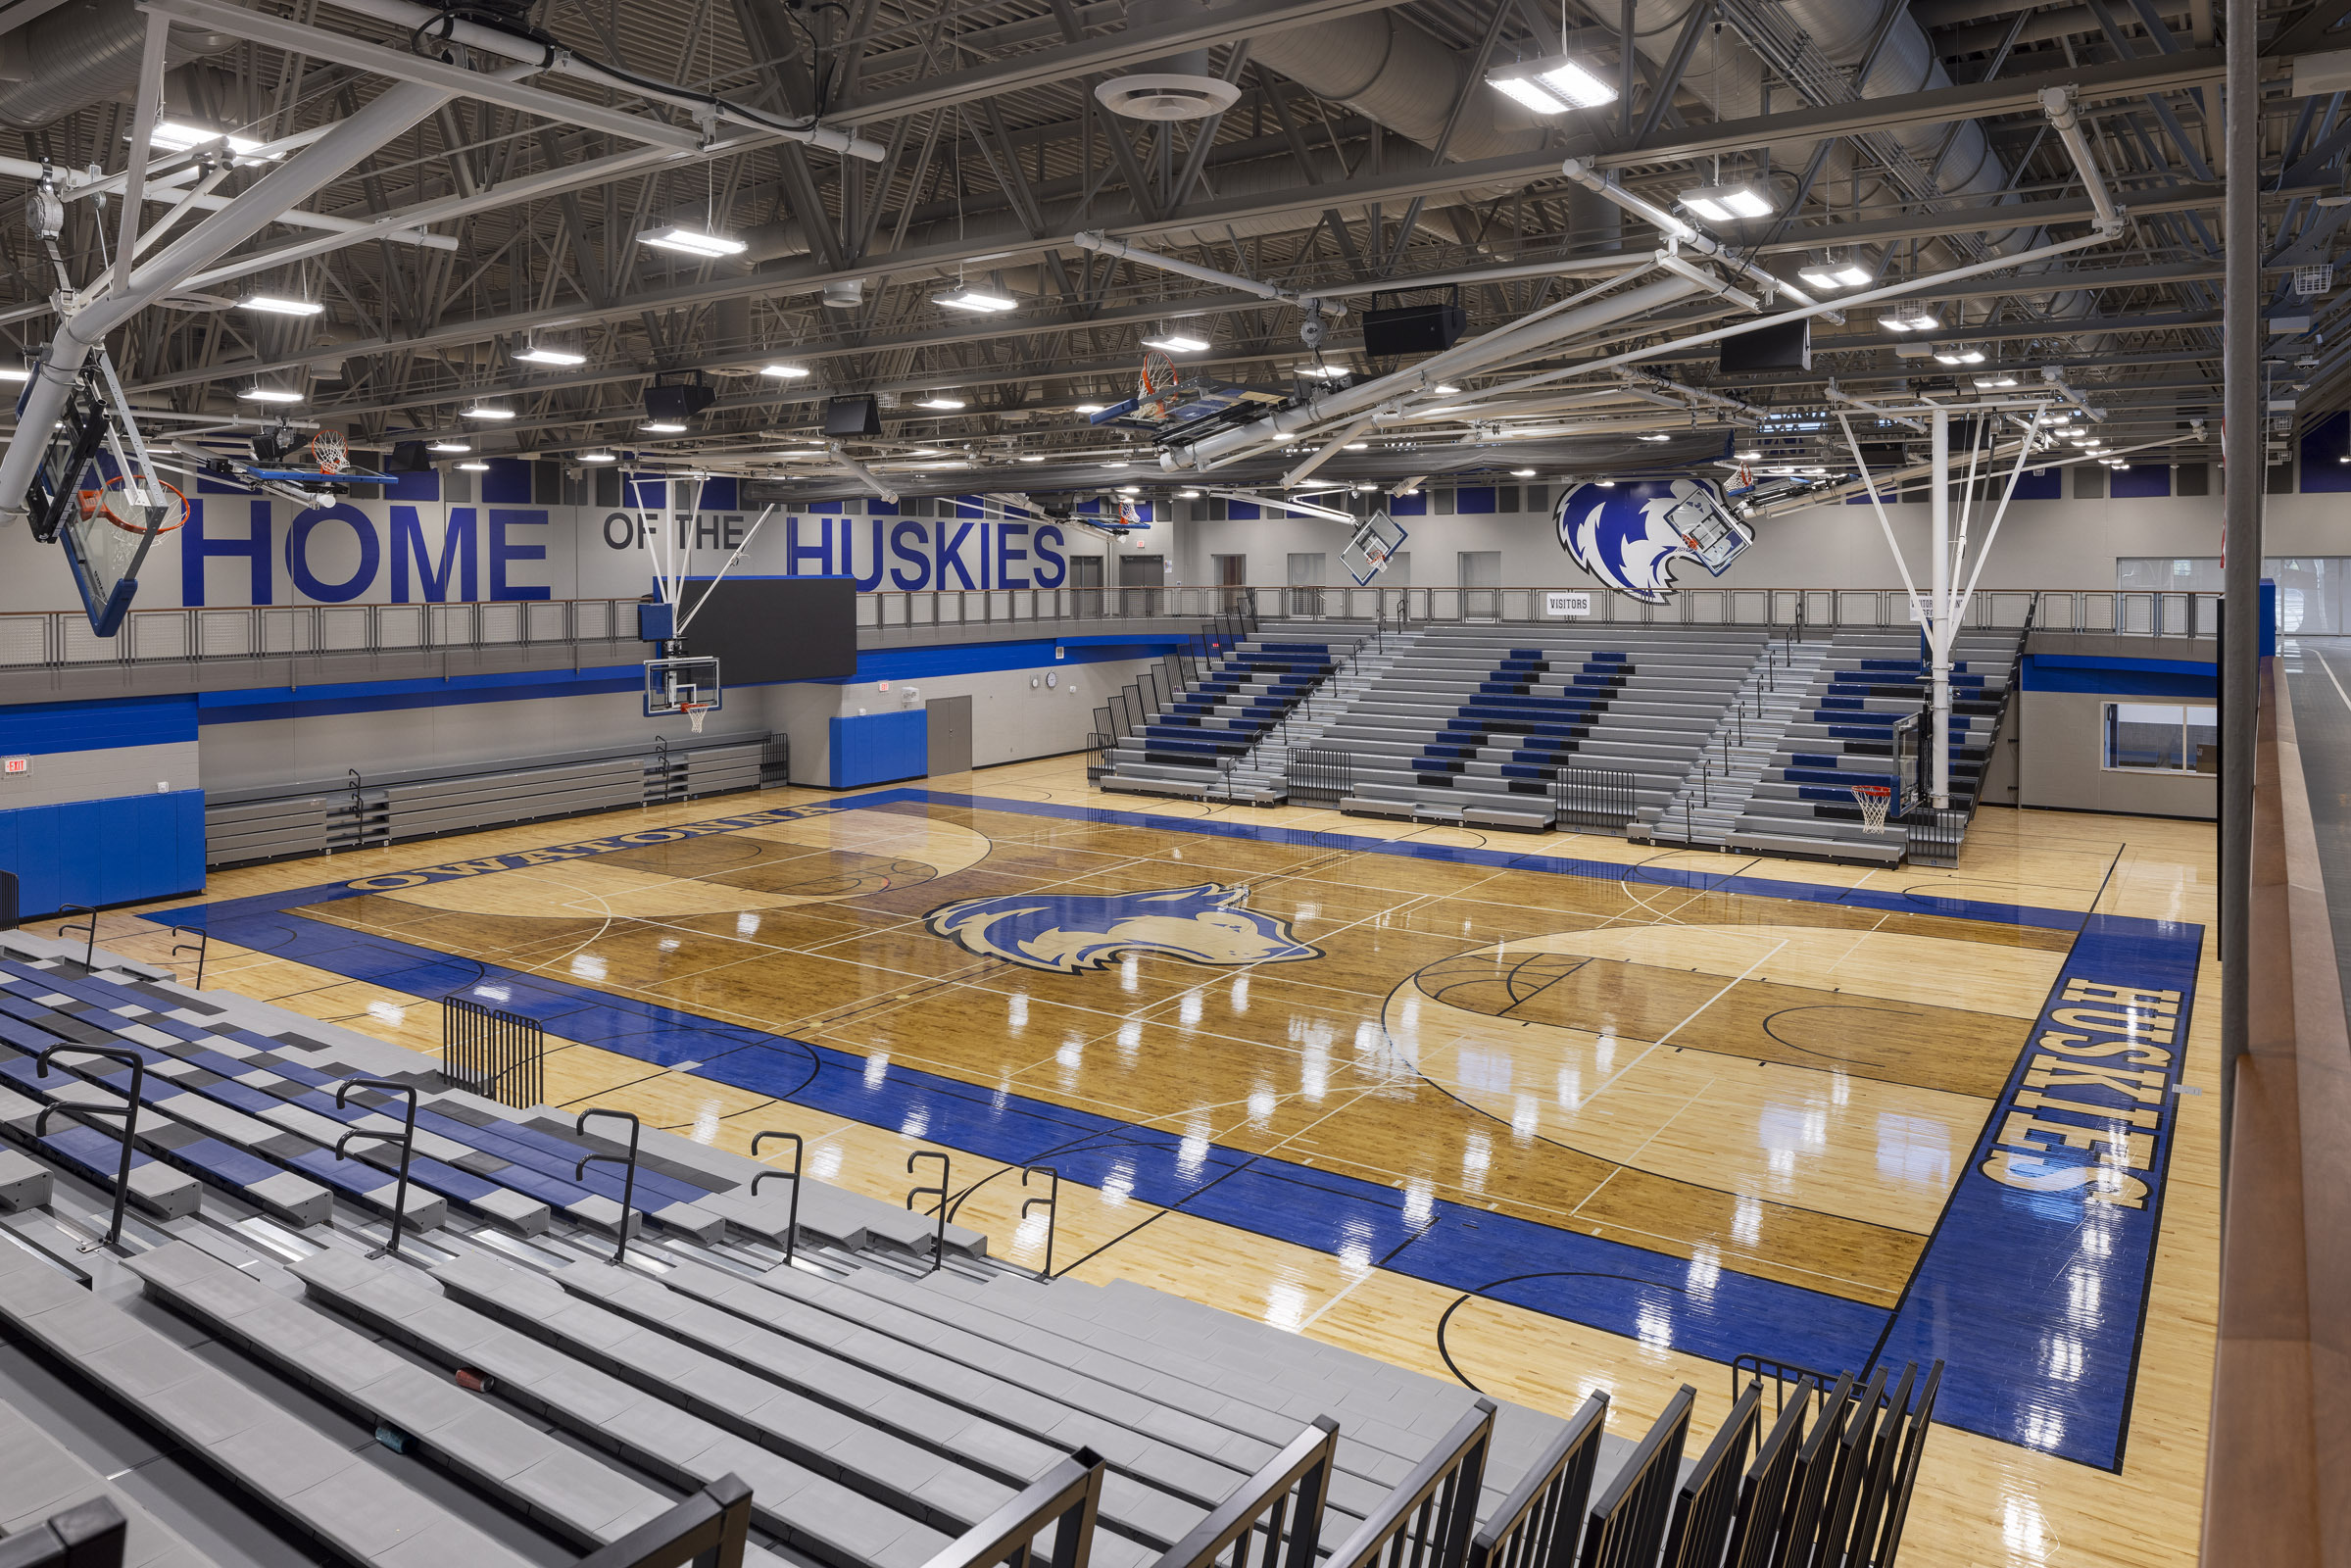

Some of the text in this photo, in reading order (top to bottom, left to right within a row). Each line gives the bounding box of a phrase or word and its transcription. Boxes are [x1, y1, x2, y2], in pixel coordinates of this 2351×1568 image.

[181, 499, 551, 607] HOME
[603, 512, 745, 550] OF THE
[787, 516, 1066, 592] HUSKIES
[1550, 599, 1588, 609] VISITORS
[9, 760, 24, 771] EXIT
[345, 804, 851, 891] OWATONNA
[1978, 977, 2184, 1211] HUSKIES
